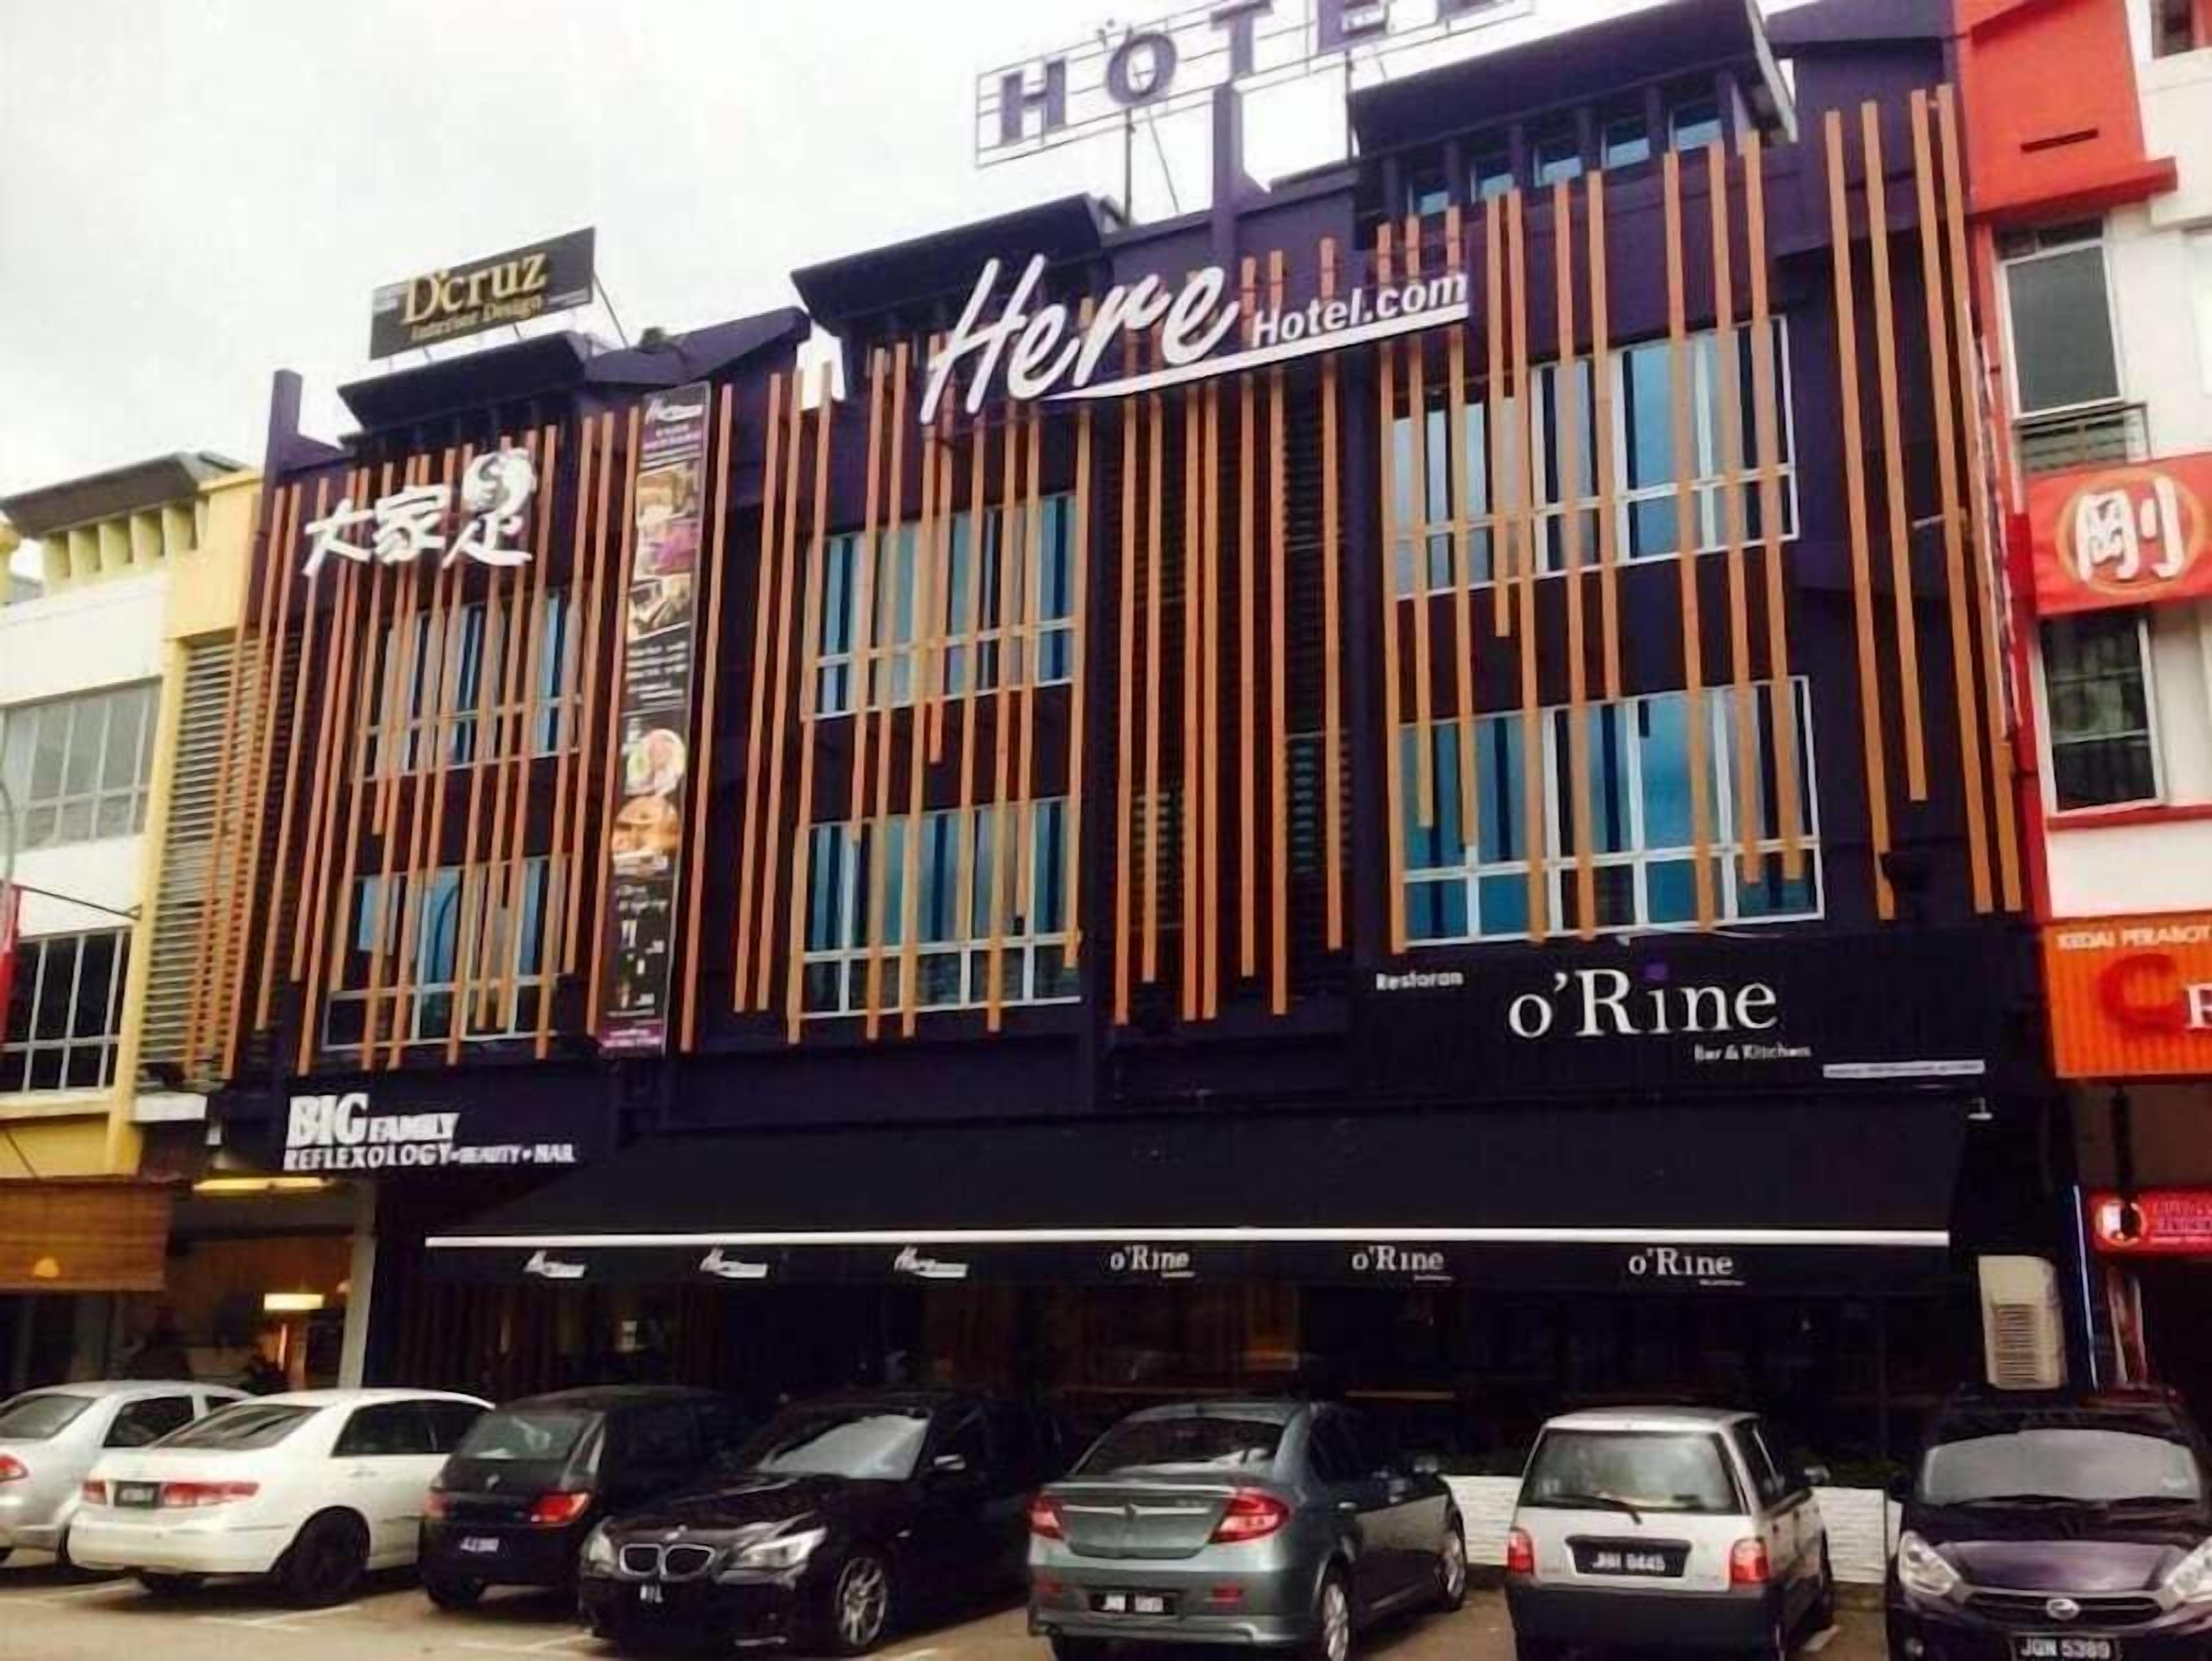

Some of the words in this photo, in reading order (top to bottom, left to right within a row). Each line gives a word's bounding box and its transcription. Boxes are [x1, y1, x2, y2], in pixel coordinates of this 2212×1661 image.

[920, 253, 1240, 425] Here
[1251, 273, 1470, 349] Hotel.com
[1508, 963, 1777, 1038] o'Rine
[285, 1093, 369, 1146] BIG
[283, 1142, 453, 1171] REFLEXOLOGY
